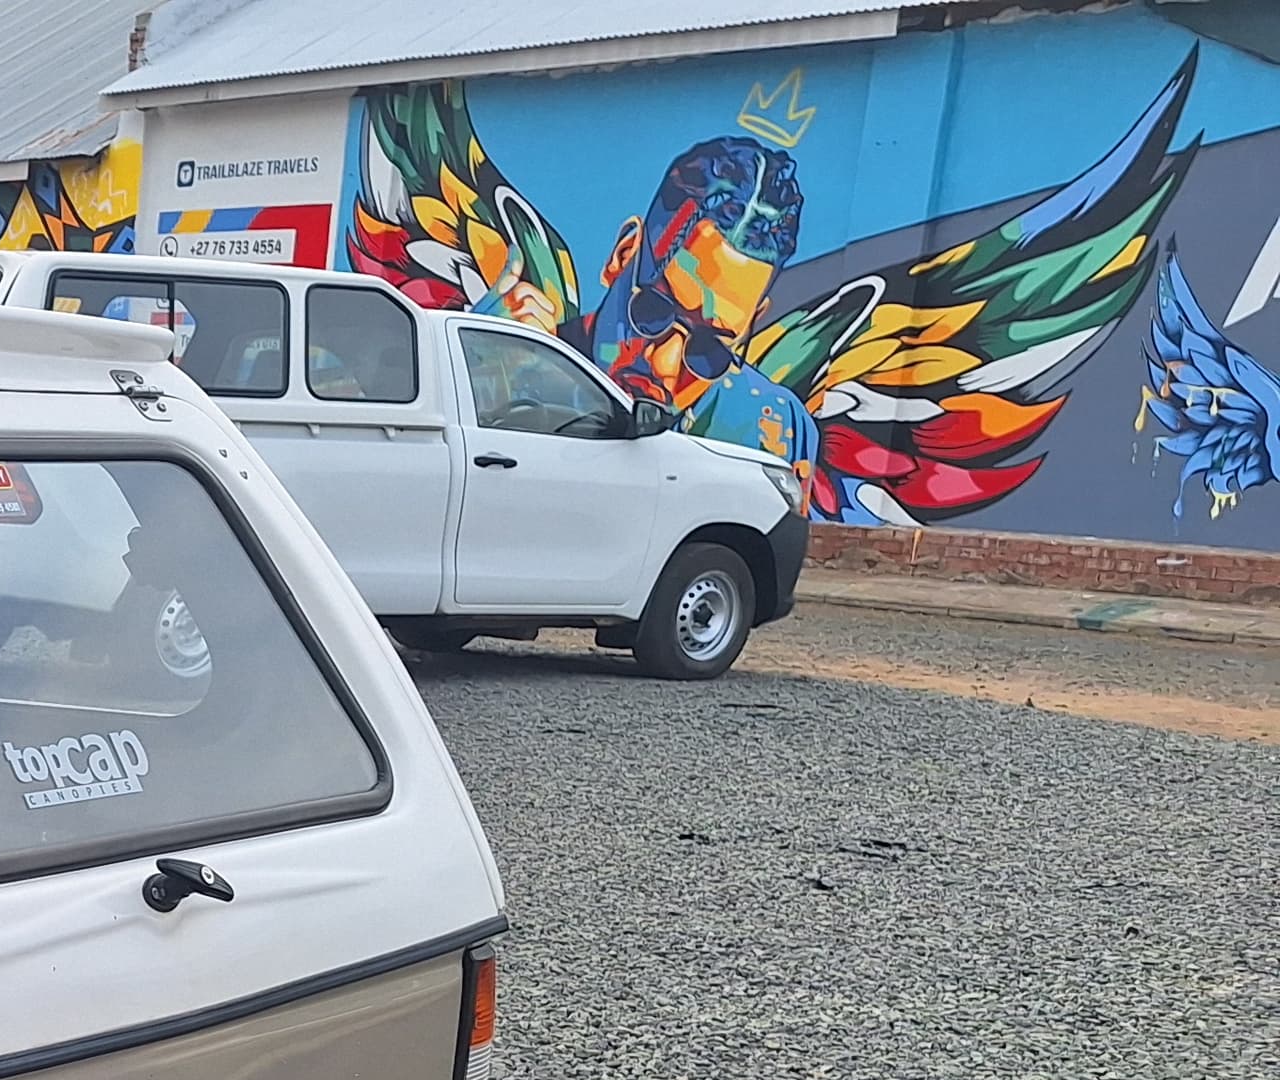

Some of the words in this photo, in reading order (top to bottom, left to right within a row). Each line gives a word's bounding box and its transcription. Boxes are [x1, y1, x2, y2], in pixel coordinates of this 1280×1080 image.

[197, 160, 264, 181] TRAILBLAZE
[267, 156, 319, 175] TRAVELS
[190, 241, 209, 255] +27
[212, 240, 226, 255] 76
[229, 240, 249, 255] 733
[252, 239, 282, 254] 4554
[27, 780, 133, 806] CANOPIES
